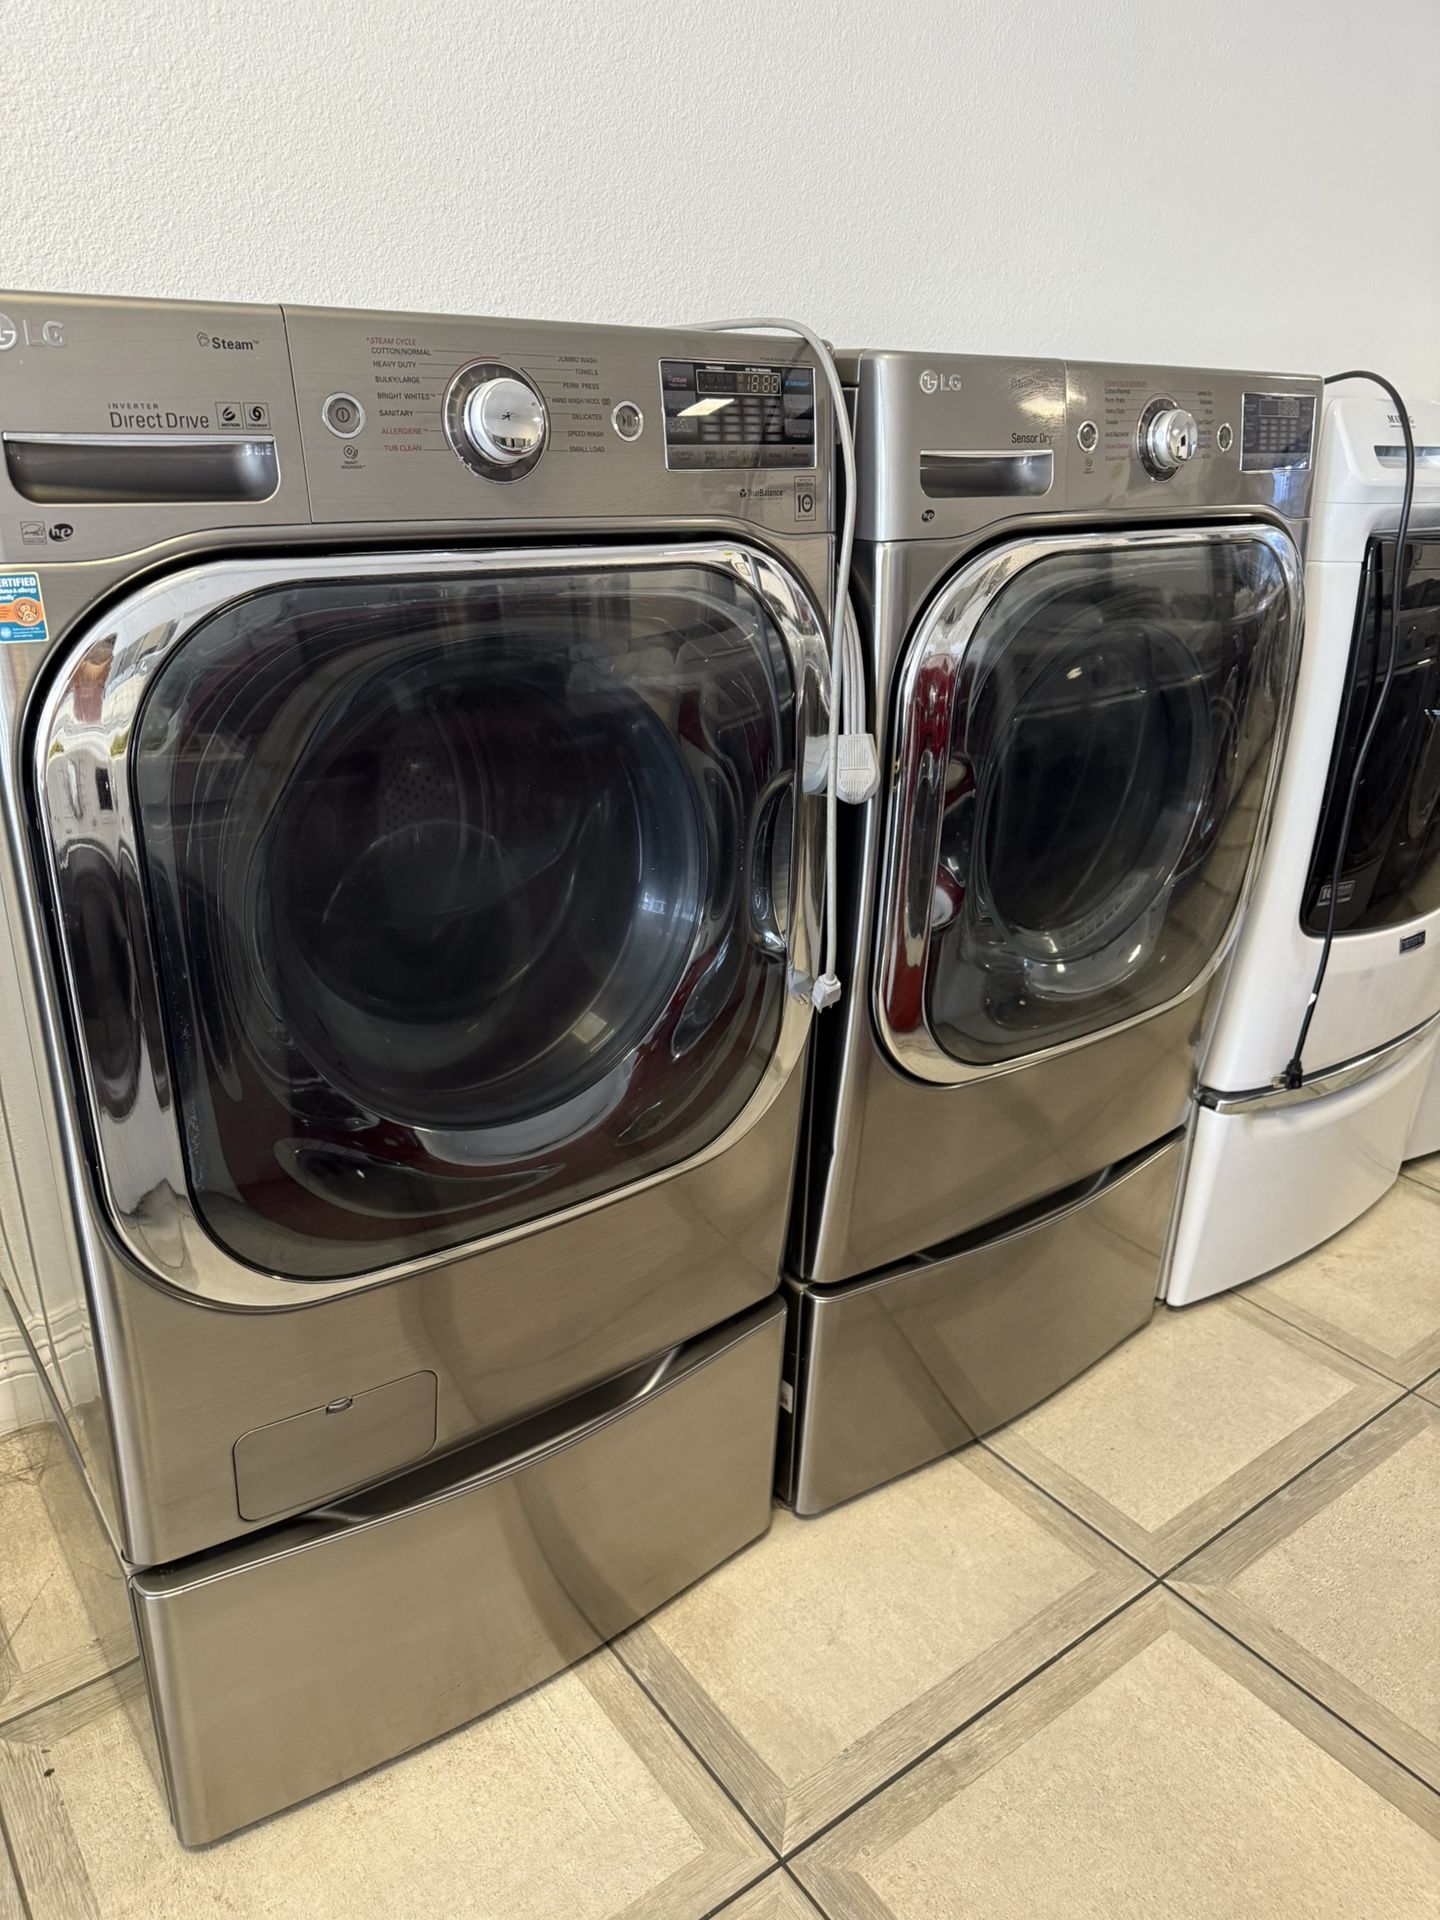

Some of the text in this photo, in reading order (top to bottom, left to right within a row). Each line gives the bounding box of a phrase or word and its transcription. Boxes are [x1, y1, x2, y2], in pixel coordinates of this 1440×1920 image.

[23, 319, 65, 347] LG
[396, 338, 416, 346] CYCLE
[373, 360, 416, 369] HEAVY DUTY
[574, 367, 599, 376] TOWELS
[941, 373, 962, 392] LG
[377, 392, 402, 400] BRIGHT
[108, 402, 159, 411] INVERTER
[379, 409, 414, 417] SANITARY
[571, 412, 602, 421] DELICATES
[110, 411, 210, 429] Direct Drive
[567, 430, 586, 438] SPEED
[1011, 432, 1054, 446] Sensor Dry
[384, 444, 422, 452] TUB CLEAN
